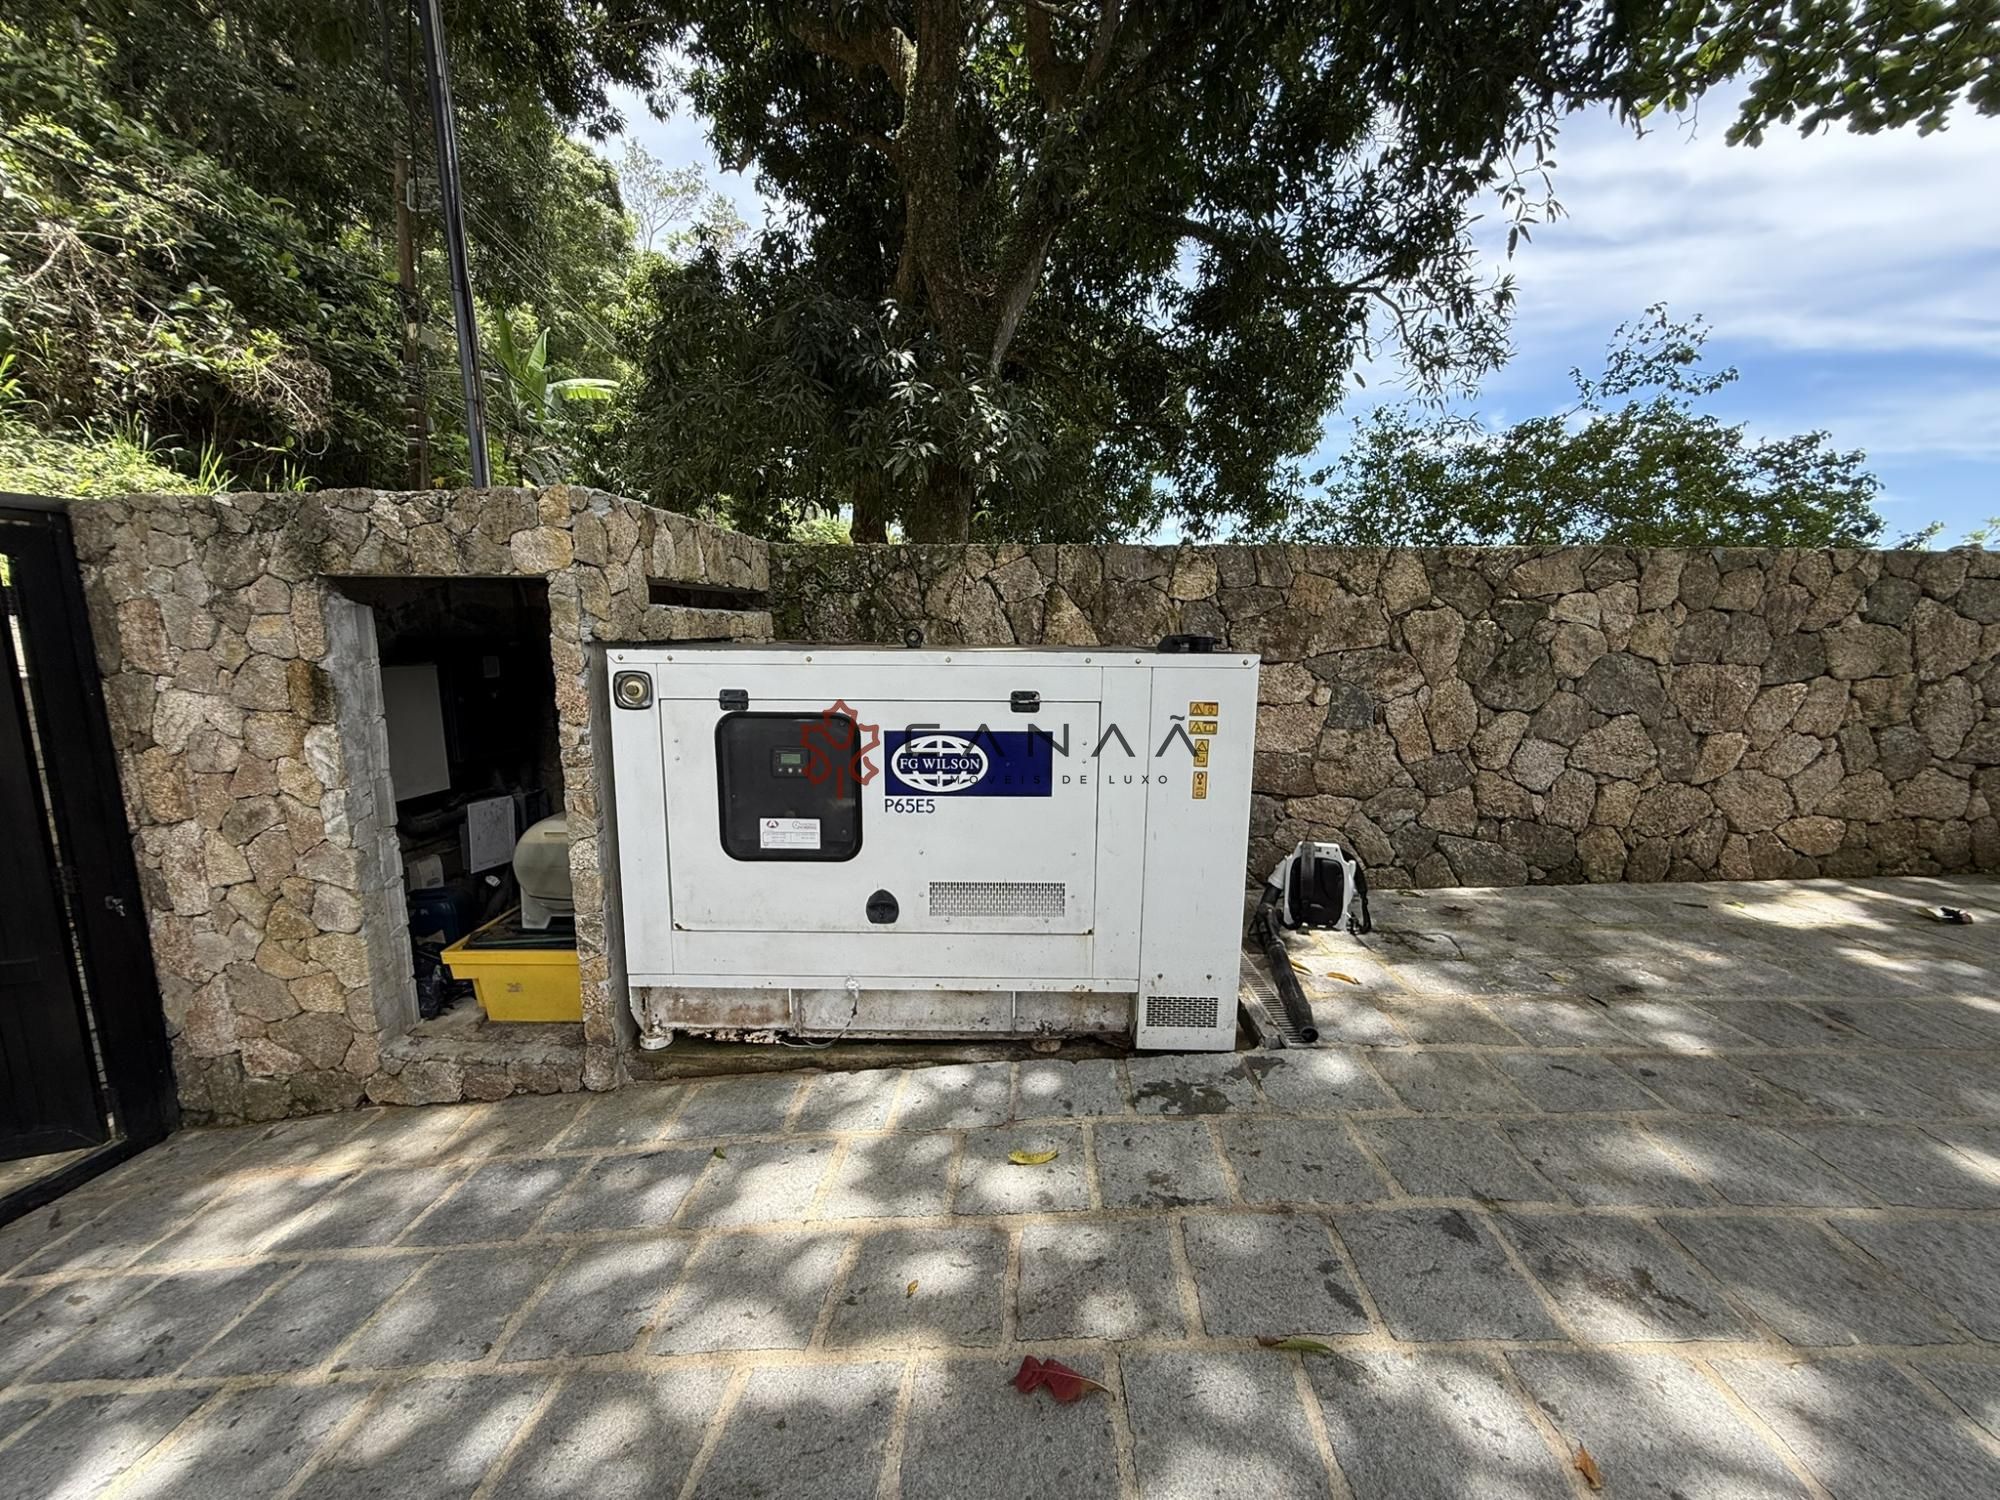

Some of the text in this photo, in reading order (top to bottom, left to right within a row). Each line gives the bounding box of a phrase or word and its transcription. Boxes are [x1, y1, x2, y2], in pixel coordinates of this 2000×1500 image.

[900, 758, 980, 770] FG WILSON
[884, 799, 936, 814] P65E5
